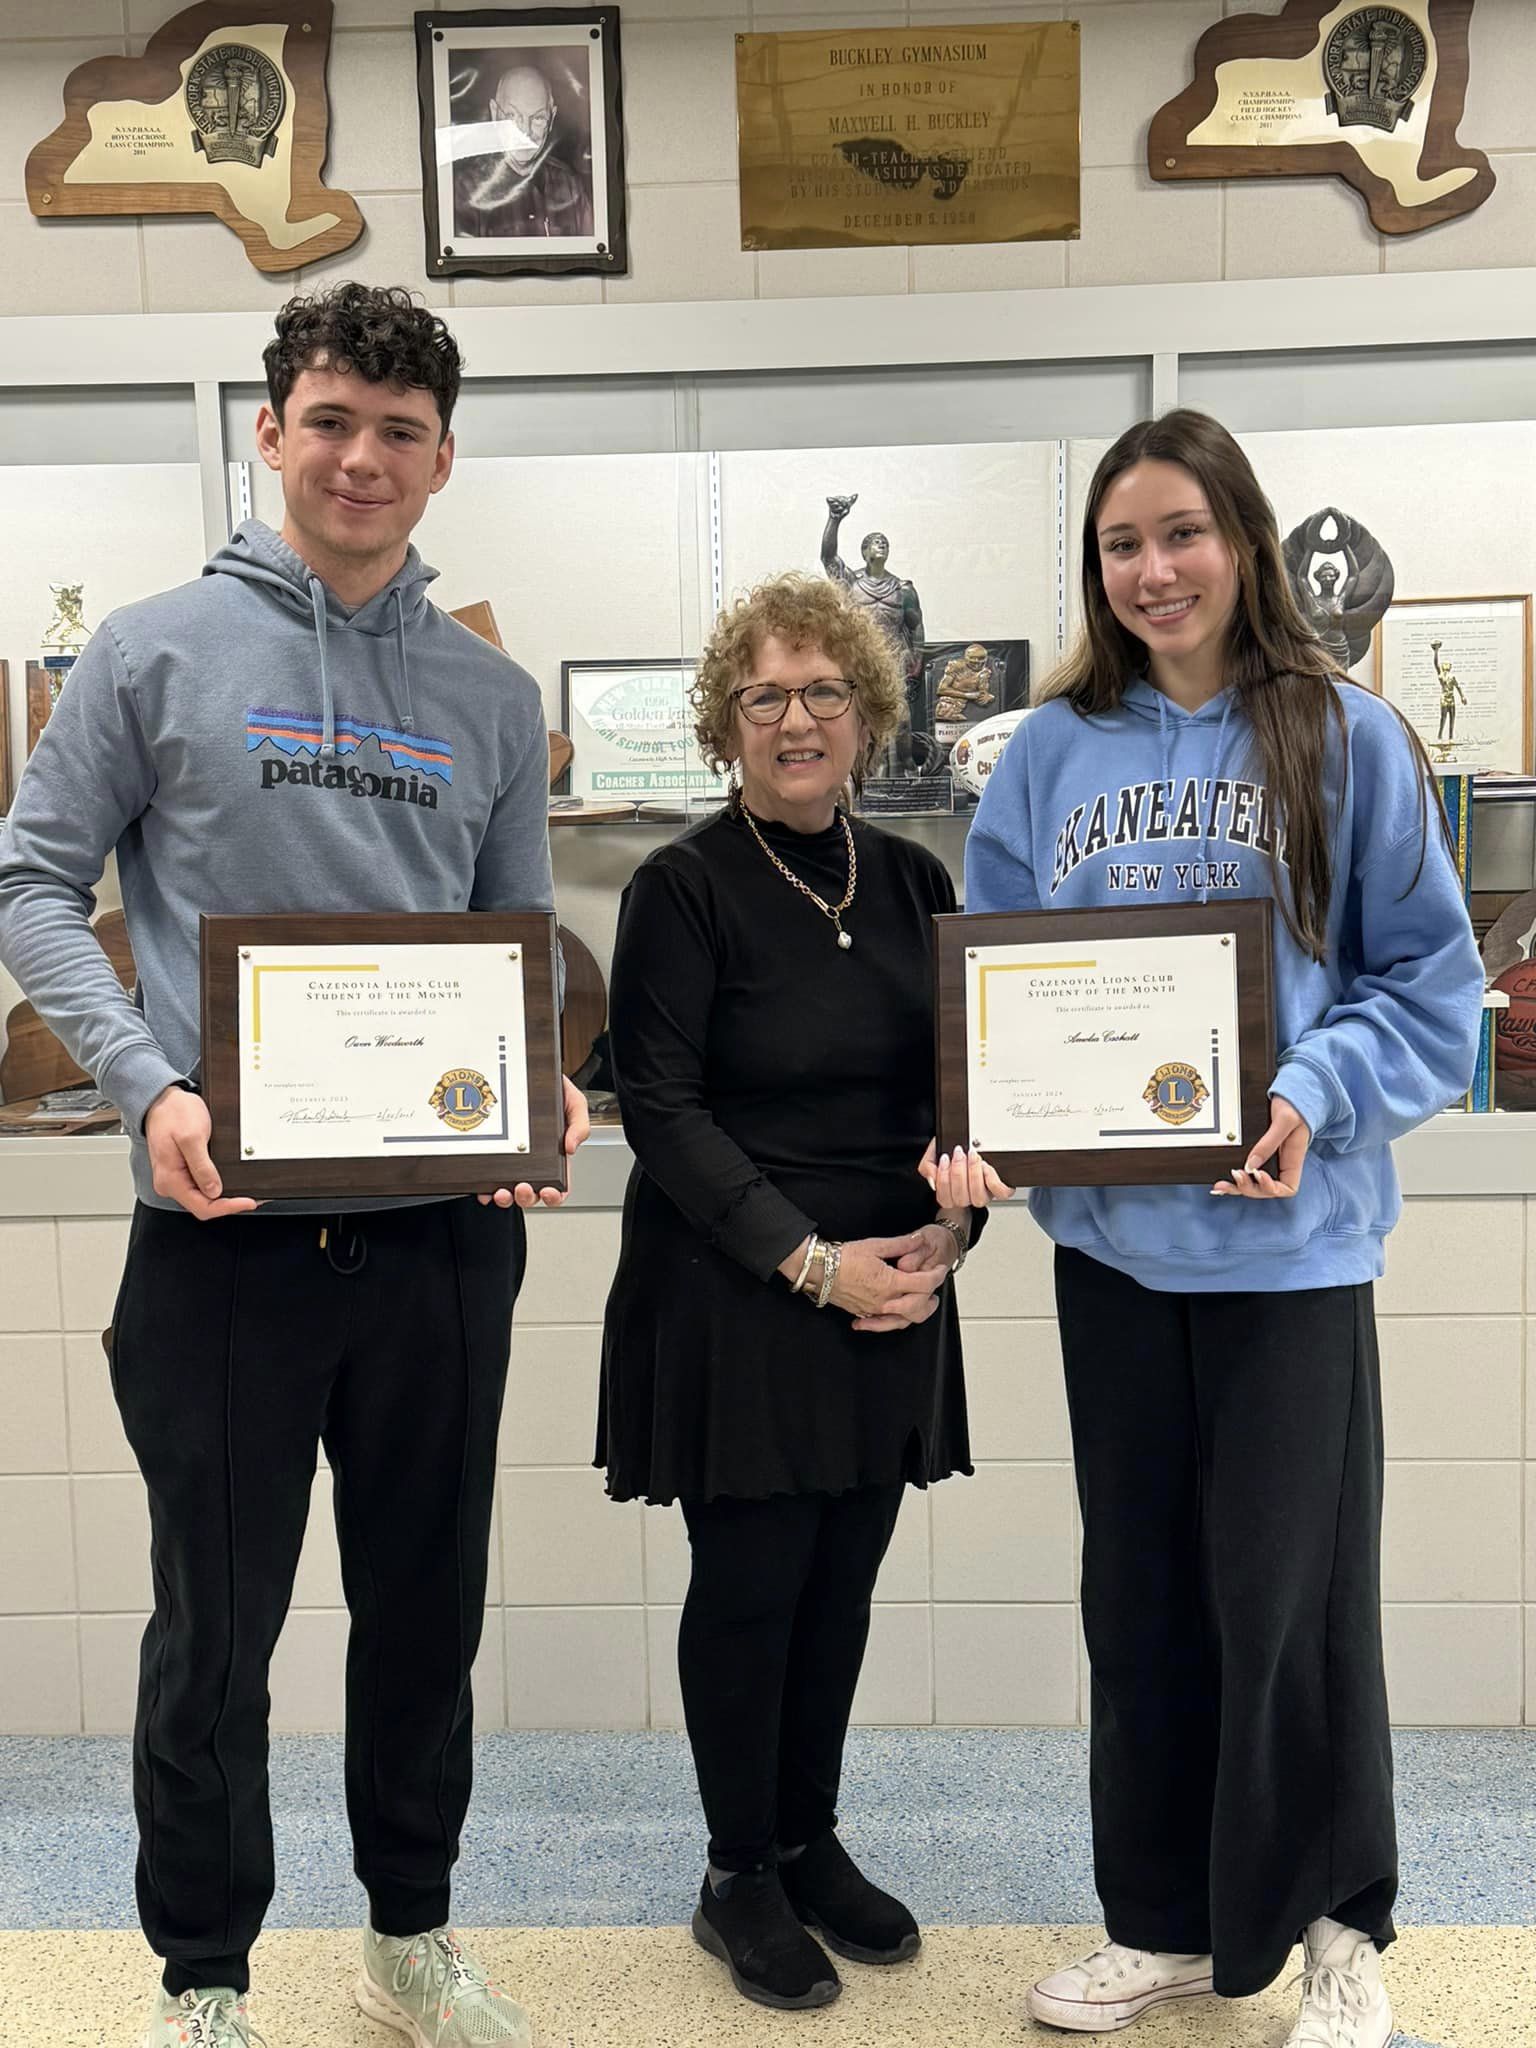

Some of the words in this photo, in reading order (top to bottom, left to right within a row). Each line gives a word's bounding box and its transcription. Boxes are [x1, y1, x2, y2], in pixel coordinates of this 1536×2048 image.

[1330, 39, 1343, 71] YORK
[1340, 10, 1376, 36] STATE
[1378, 10, 1415, 34] PUBLIC
[830, 47, 893, 66] BUCKLEY
[902, 44, 987, 64] GYMNASIUM
[188, 78, 201, 109] YORK
[195, 48, 228, 74] STATE
[860, 83, 875, 97] IN
[882, 81, 931, 96] HONOR
[939, 80, 957, 95] OF
[829, 115, 896, 134] MAXWELL
[907, 114, 920, 132] H.
[928, 111, 992, 130] BUCKLEY
[104, 141, 127, 149] CLASS
[133, 141, 175, 149] CHAMPIONS
[843, 213, 922, 229] DECEMBER
[616, 737, 666, 754] SCHOOL
[260, 759, 437, 810] patagonia
[596, 773, 645, 789] COACHES
[1107, 863, 1163, 891] NEW
[1174, 861, 1241, 889] YORK
[336, 1009, 351, 1017] This
[1070, 1005, 1104, 1013] certificate
[1114, 1003, 1141, 1011] awarded
[344, 1035, 371, 1049] Owen
[374, 1034, 425, 1048] Woodworth
[446, 1071, 483, 1085] LIONS
[1159, 1065, 1194, 1077] LIONS
[454, 1087, 473, 1111] L
[1167, 1081, 1186, 1105] L
